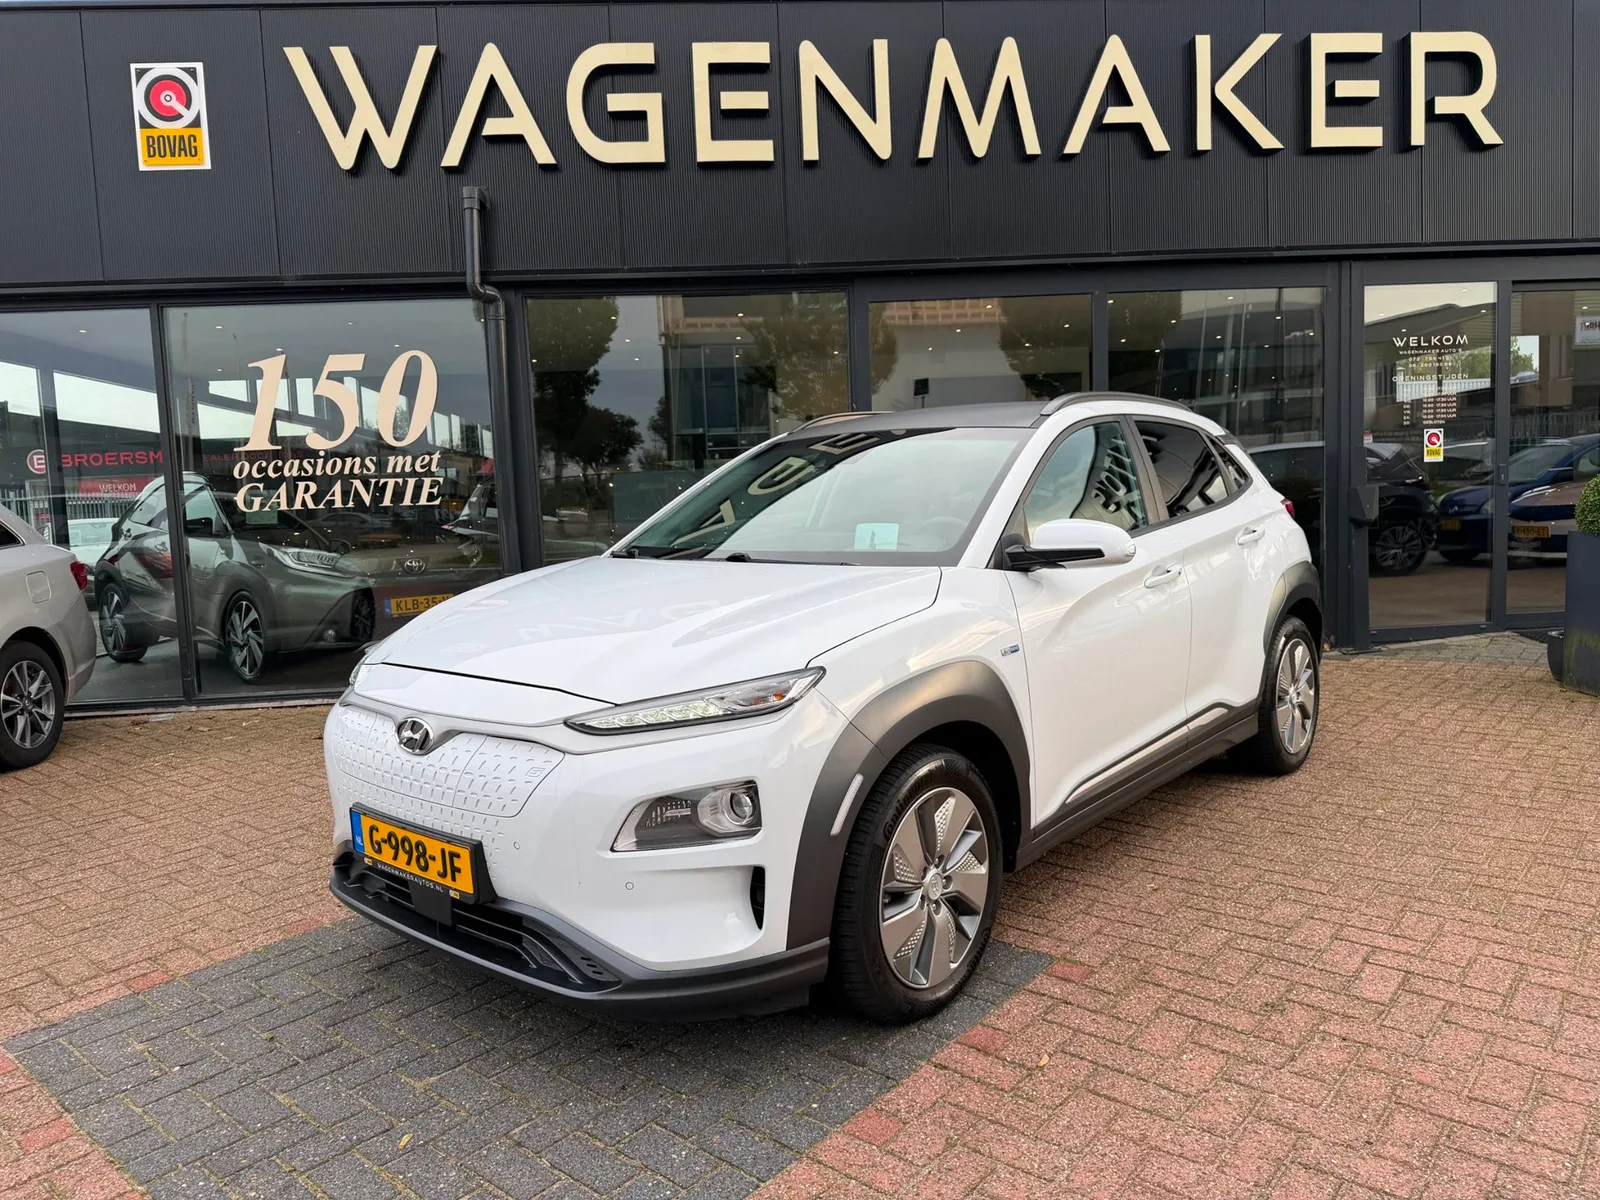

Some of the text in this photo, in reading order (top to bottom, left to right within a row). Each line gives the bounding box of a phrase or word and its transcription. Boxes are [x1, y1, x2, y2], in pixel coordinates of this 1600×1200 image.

[283, 31, 1503, 170] WAGENMAKER
[146, 134, 198, 158] BOVAG
[1392, 334, 1469, 347] WELKOM
[1392, 373, 1469, 382] OPENINGSTIJDEN
[233, 350, 438, 452] 150
[61, 449, 164, 468] BROERSM
[233, 450, 441, 480] occasions met
[98, 482, 137, 493] WELKOM
[234, 476, 445, 513] GARANTIE
[368, 824, 462, 882] G-998-JF
